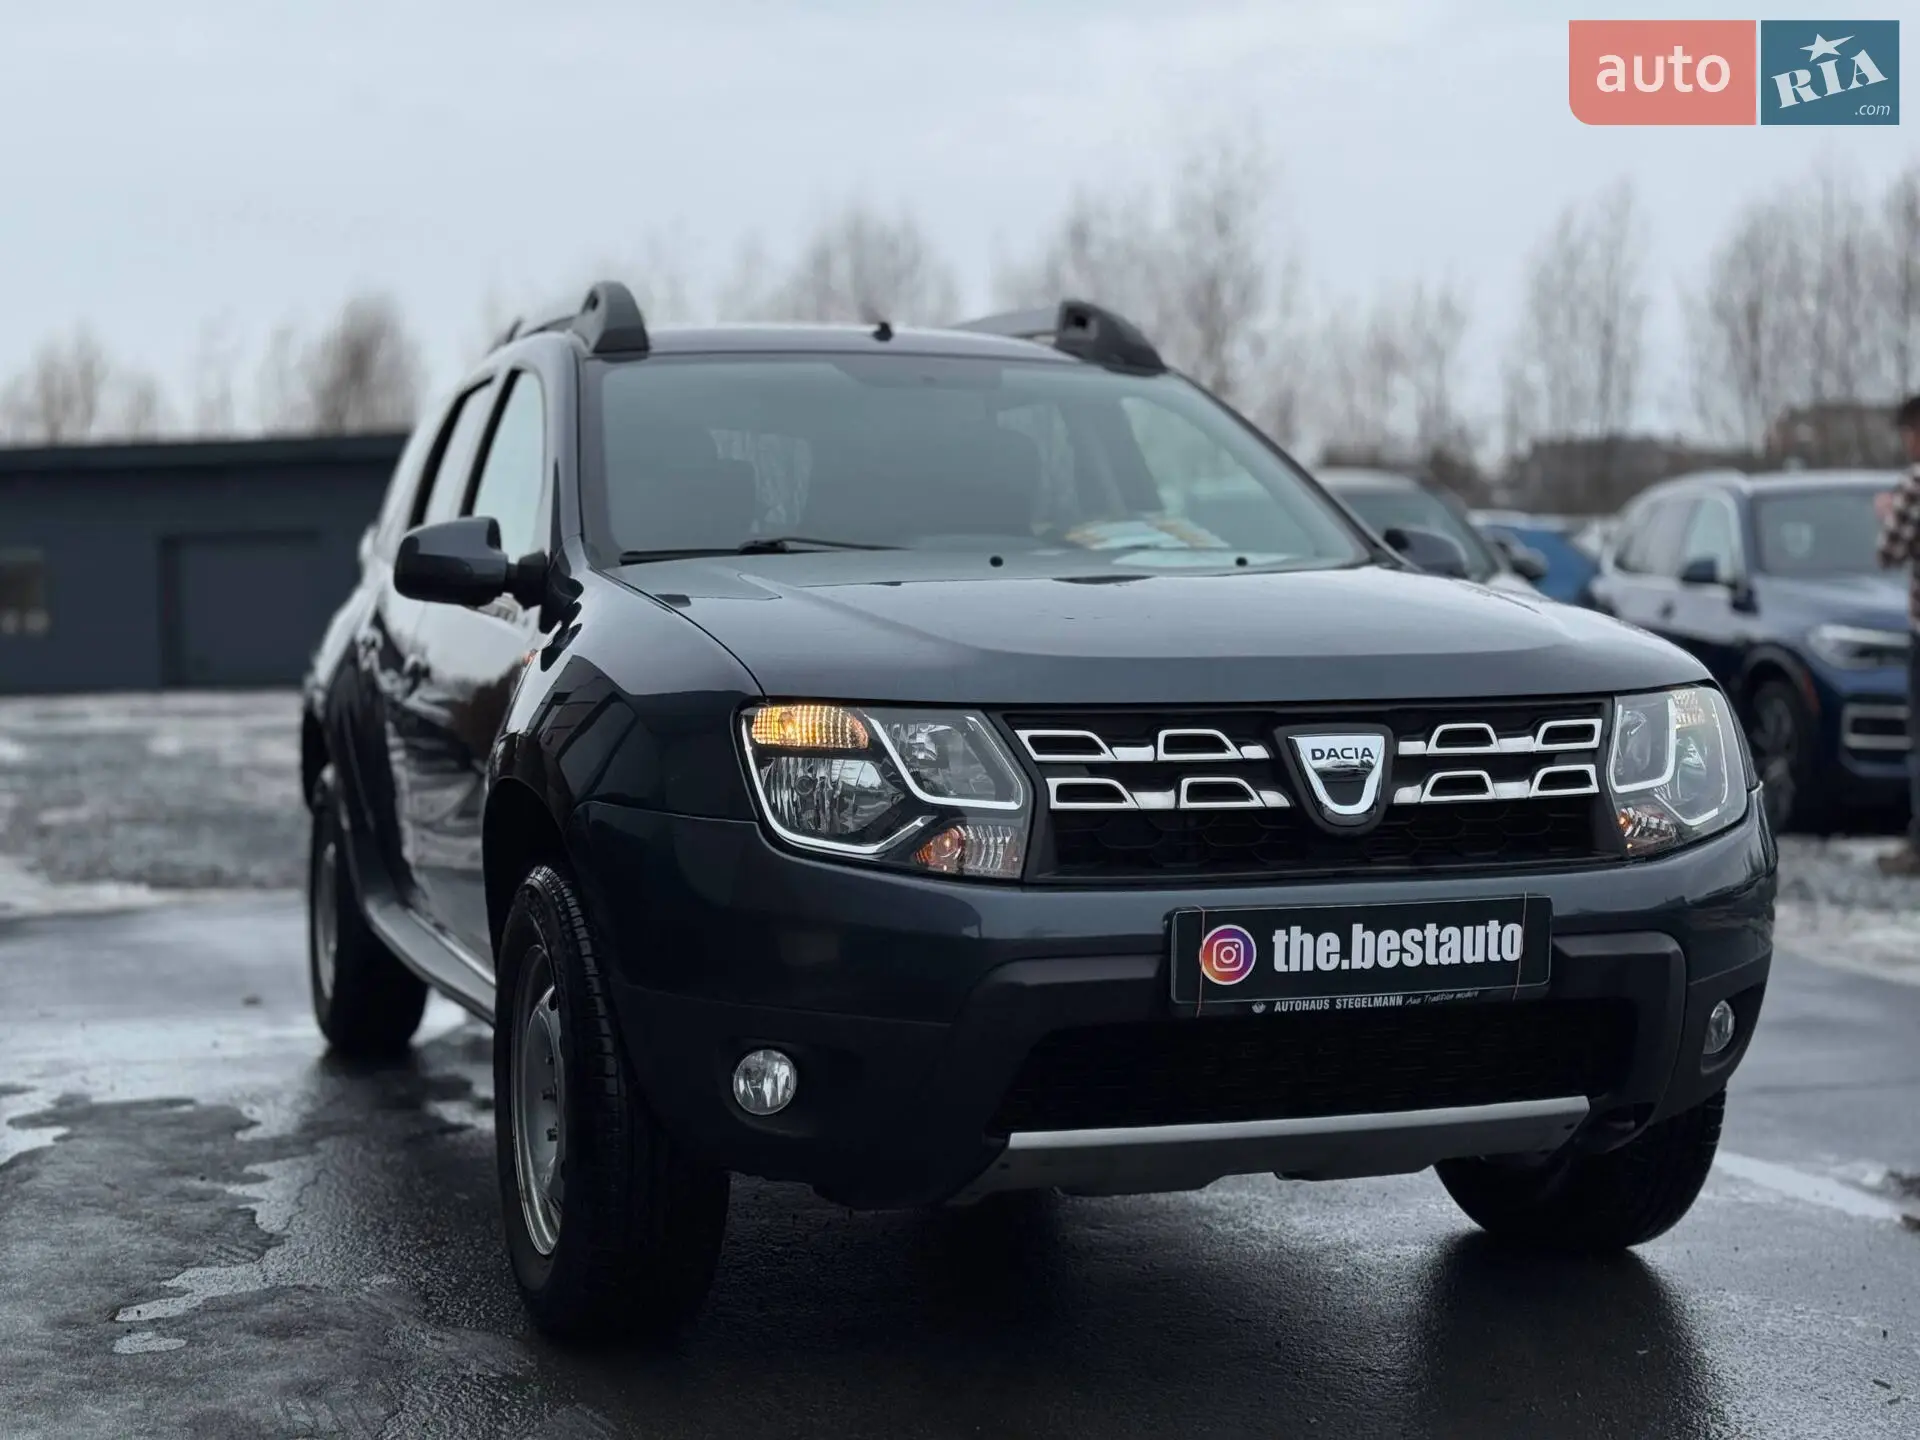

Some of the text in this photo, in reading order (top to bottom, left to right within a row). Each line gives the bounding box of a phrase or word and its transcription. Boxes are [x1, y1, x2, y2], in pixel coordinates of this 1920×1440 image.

[1310, 747, 1375, 761] DACIA
[1272, 920, 1523, 973] the.bestauto
[1273, 999, 1330, 1012] AUTOHAUS
[1335, 995, 1403, 1010] STEGELMANN
